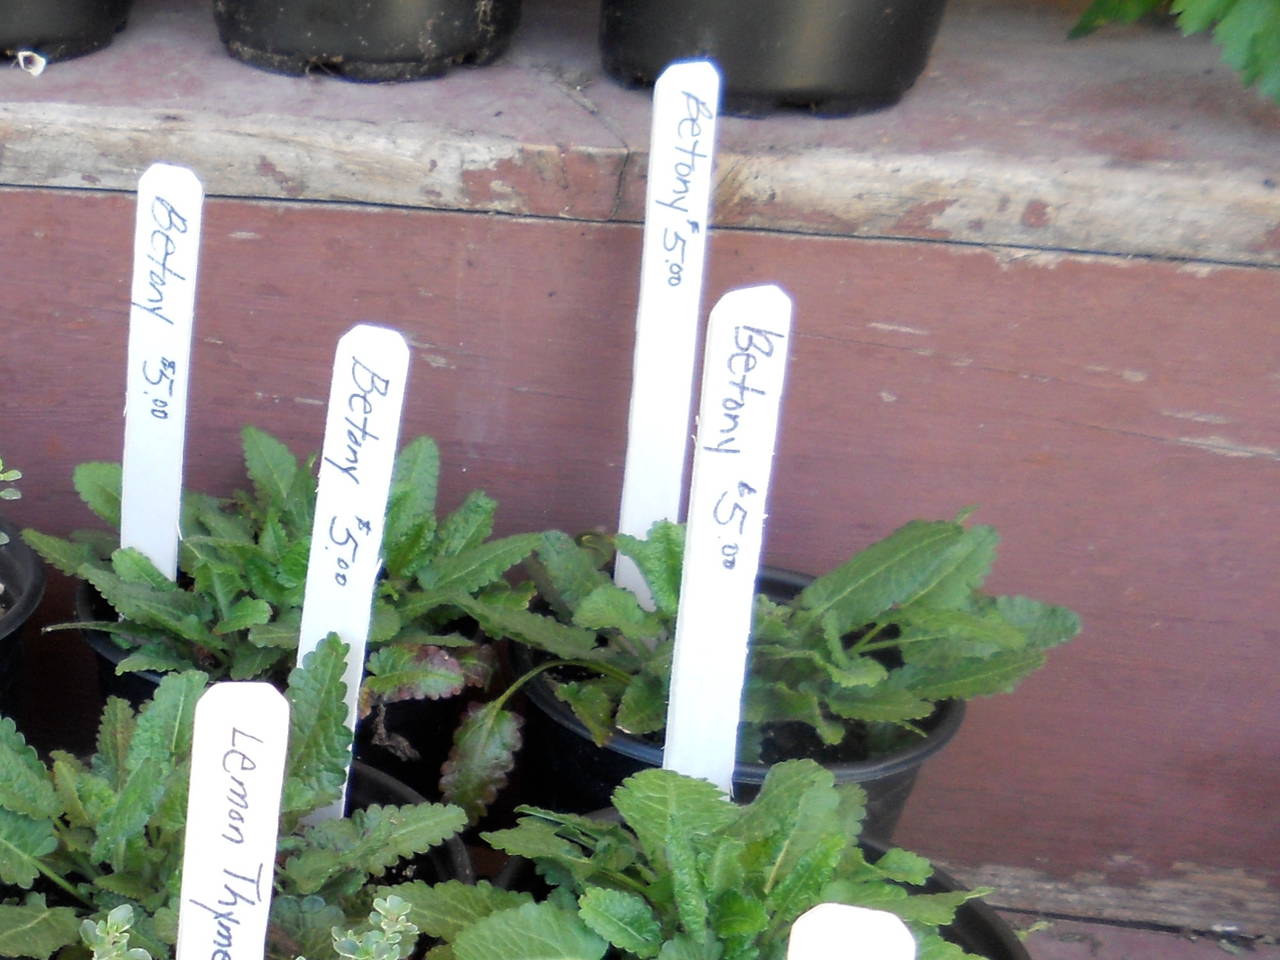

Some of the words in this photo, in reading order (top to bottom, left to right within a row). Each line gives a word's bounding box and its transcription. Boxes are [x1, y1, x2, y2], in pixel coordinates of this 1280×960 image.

[655, 91, 713, 212] Betony
[131, 196, 187, 325] Betony
[324, 356, 389, 484] Betony
[703, 325, 784, 453] Betony
[222, 727, 264, 845] Lemon
